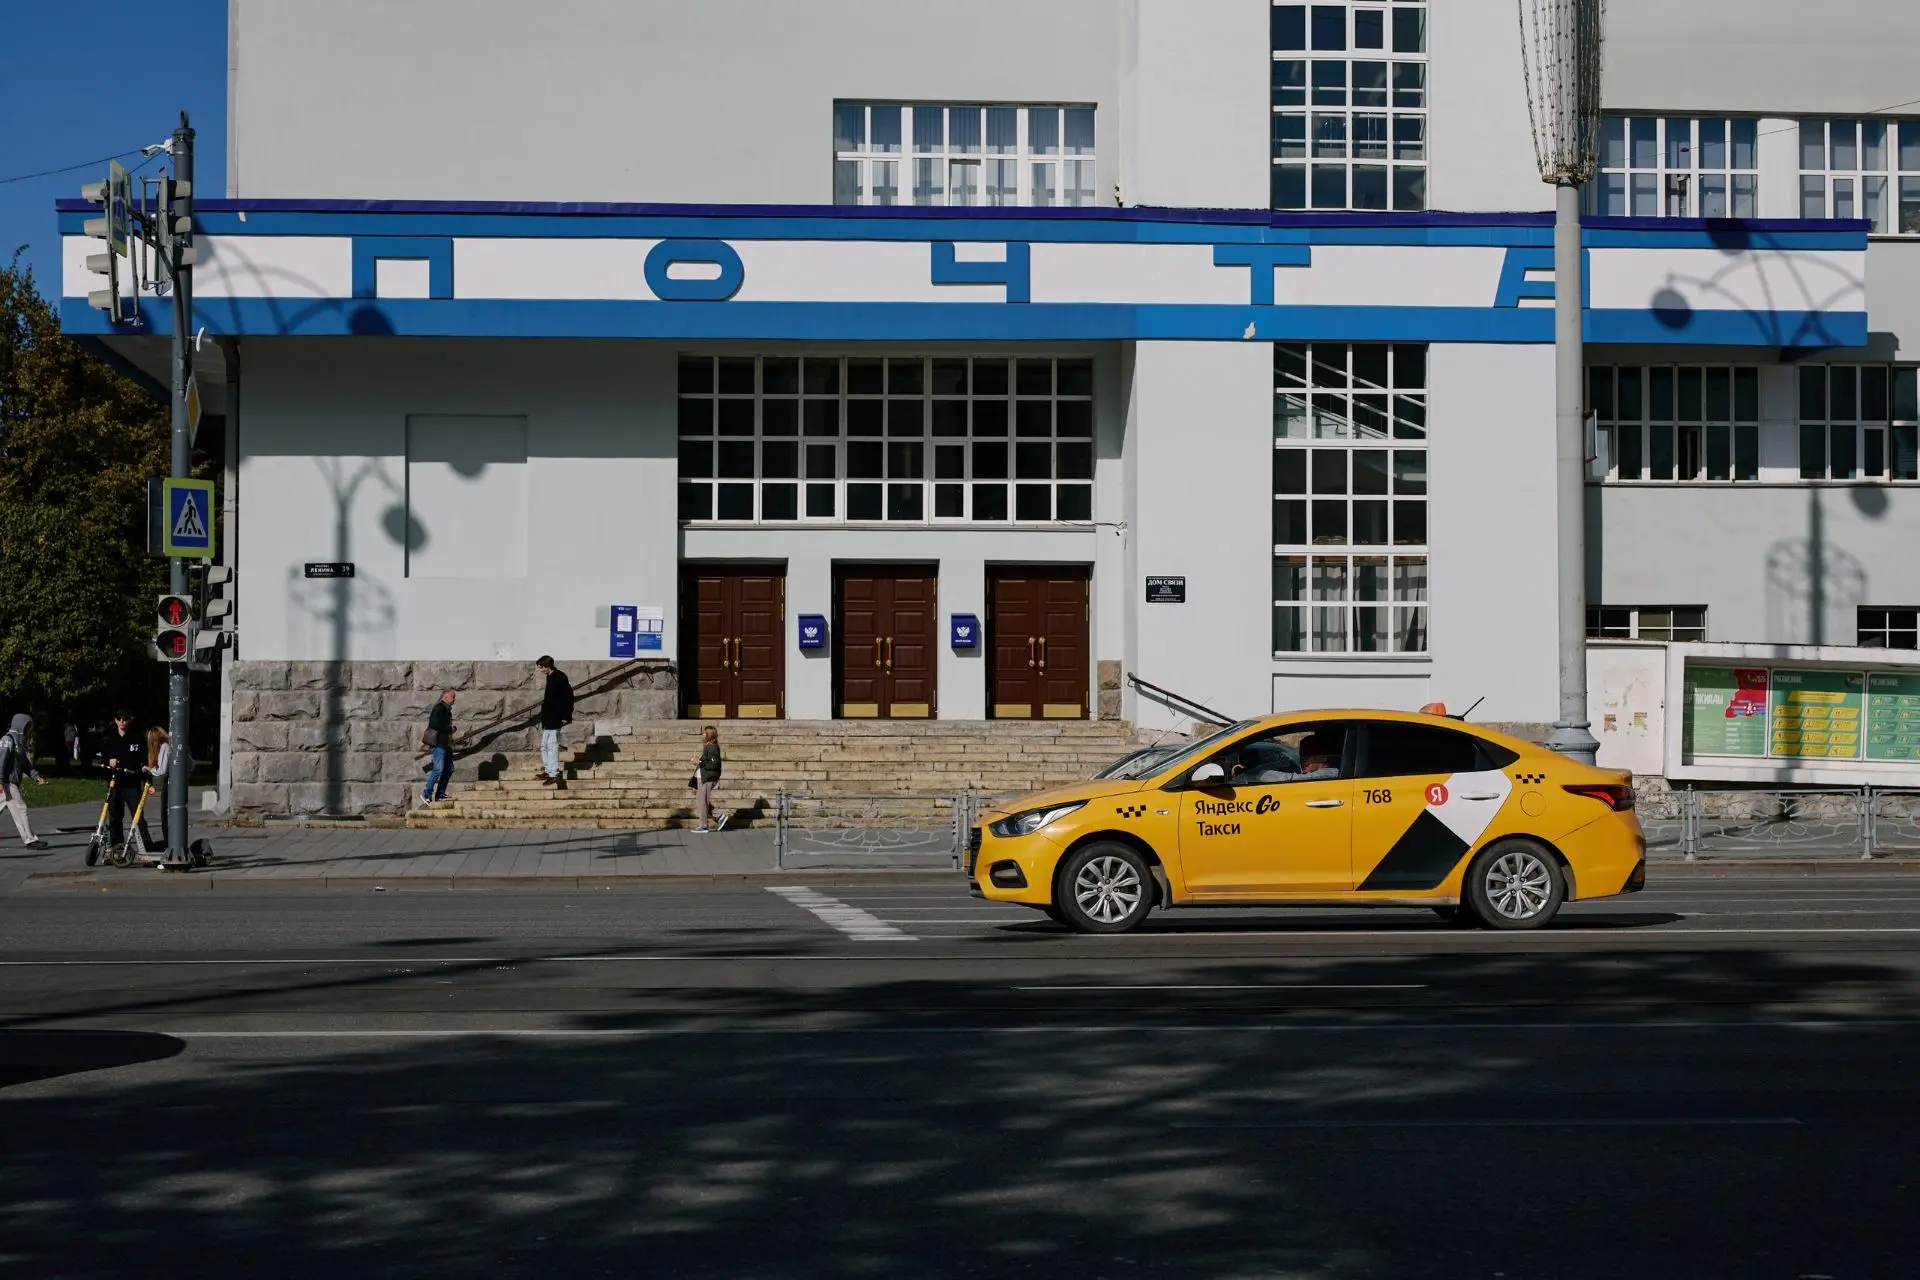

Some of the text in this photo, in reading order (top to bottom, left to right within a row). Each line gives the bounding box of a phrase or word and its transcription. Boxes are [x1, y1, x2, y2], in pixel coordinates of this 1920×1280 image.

[352, 236, 1591, 309] ПОЧТА
[1363, 788, 1392, 804] 768
[1430, 786, 1443, 803] Я
[1195, 794, 1281, 816] Яндекс Go
[1196, 821, 1241, 836] Такси
